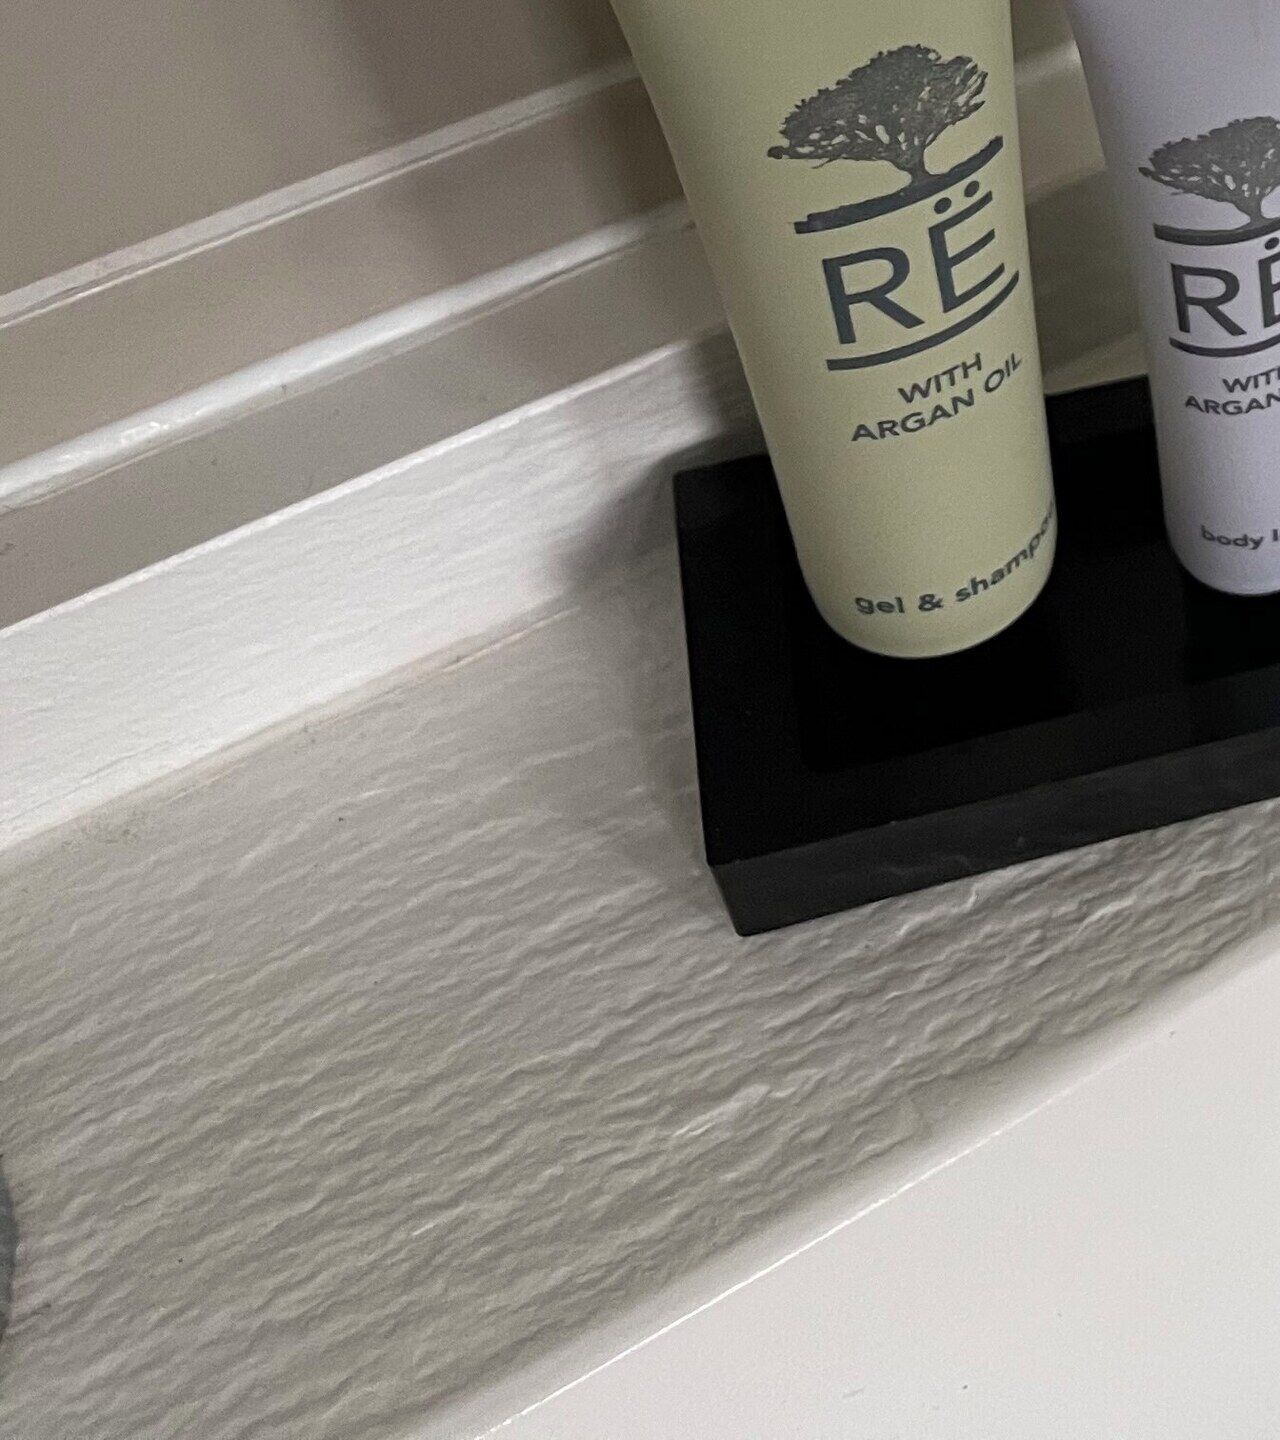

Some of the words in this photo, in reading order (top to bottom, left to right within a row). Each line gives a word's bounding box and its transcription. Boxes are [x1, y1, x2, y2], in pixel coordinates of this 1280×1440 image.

[822, 179, 1006, 345] RË
[851, 388, 975, 442] ARGAN
[984, 352, 1022, 393] OIL
[897, 352, 982, 404] WITH
[1201, 525, 1264, 550] body
[855, 597, 906, 615] gel
[918, 593, 944, 612] &
